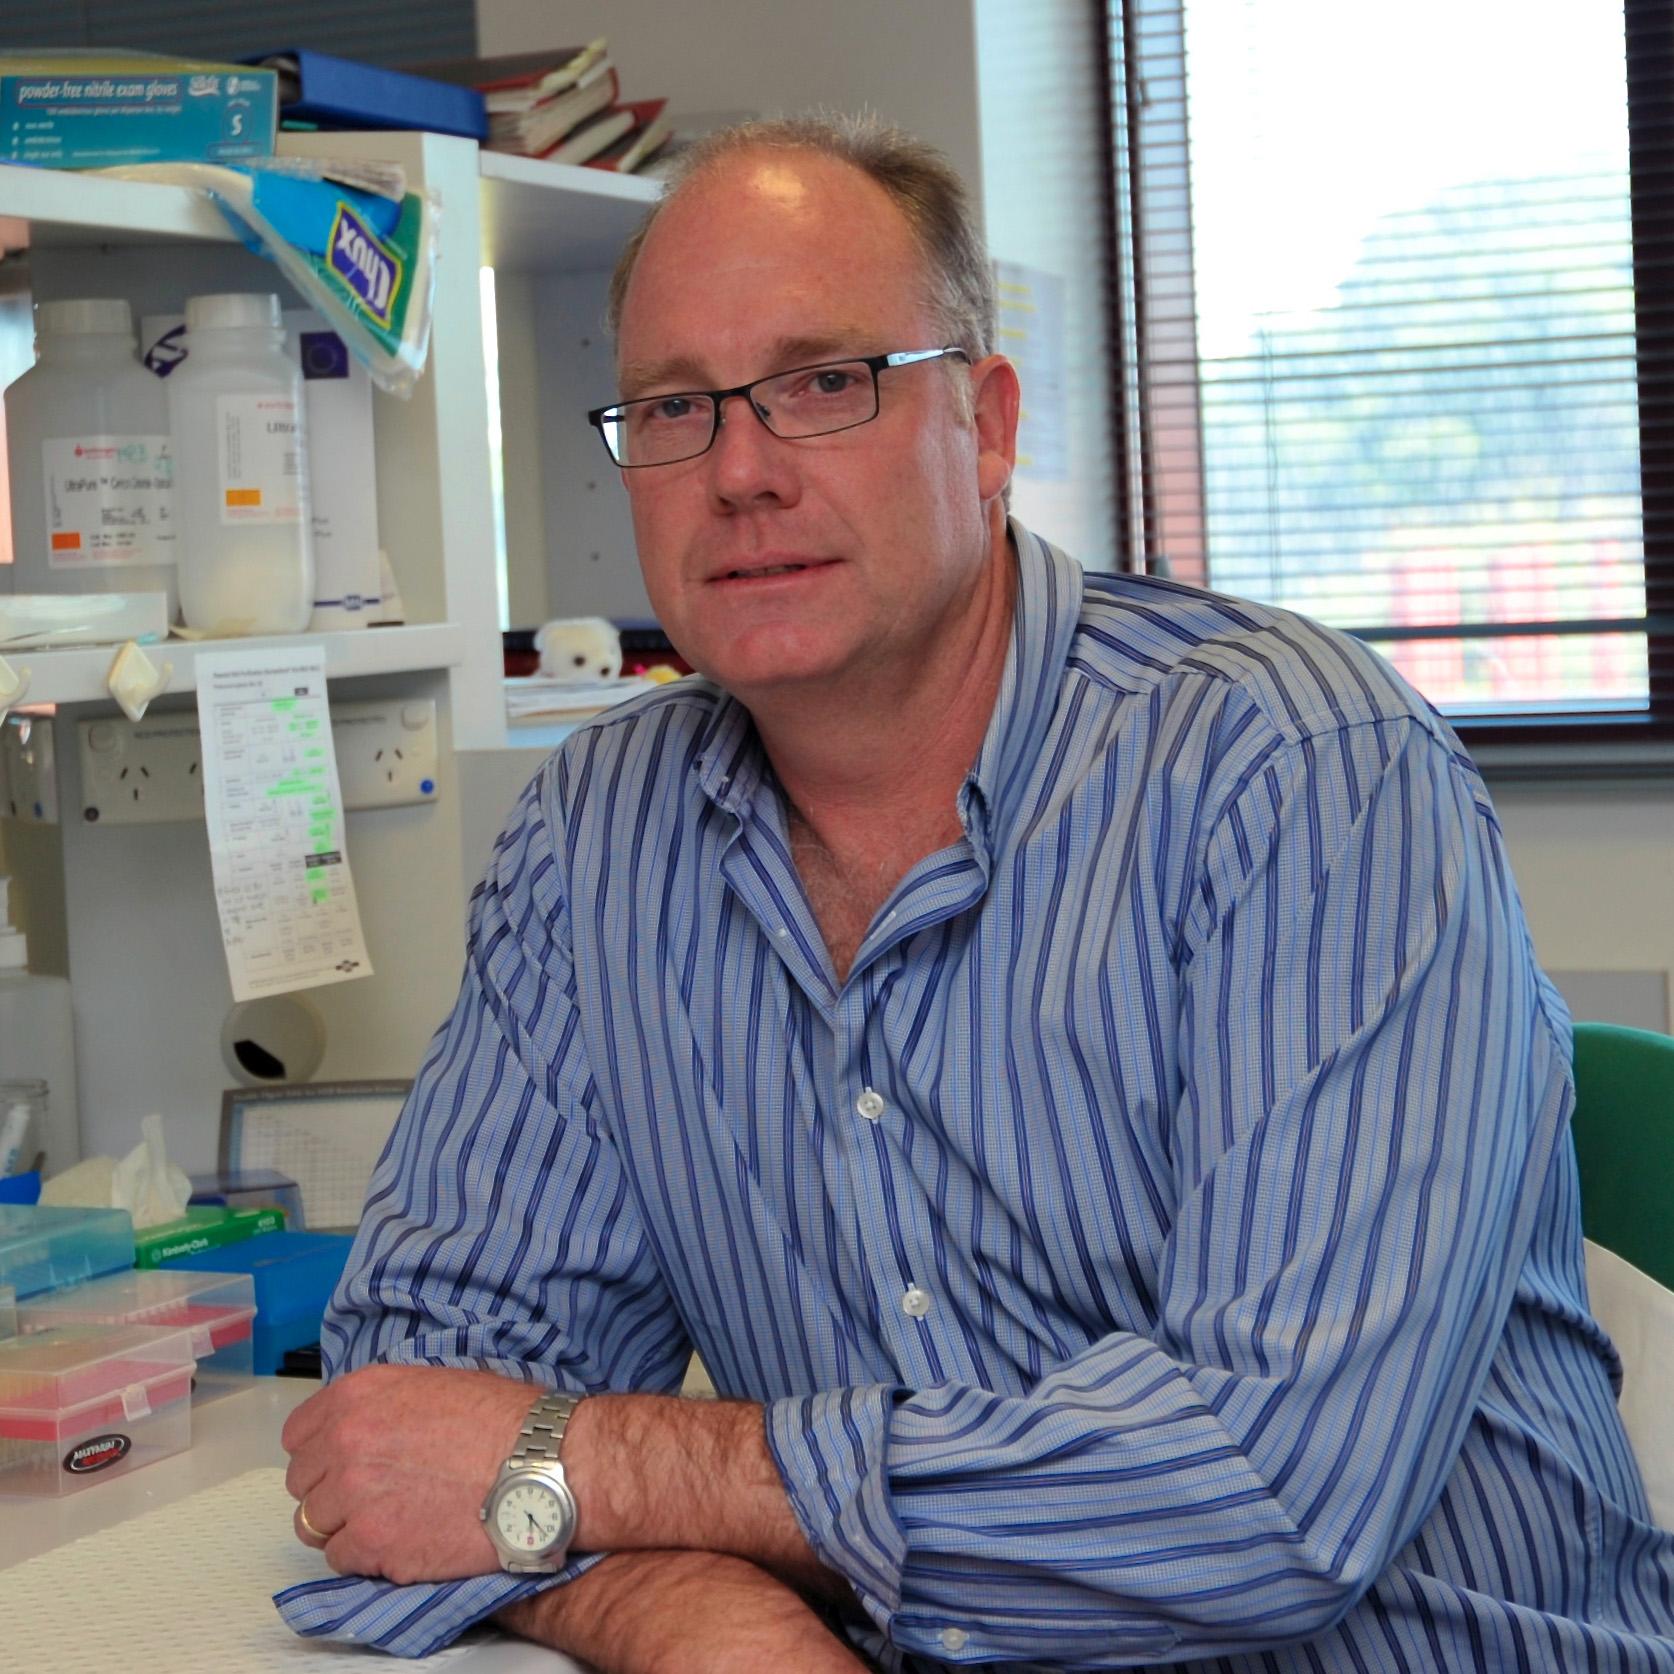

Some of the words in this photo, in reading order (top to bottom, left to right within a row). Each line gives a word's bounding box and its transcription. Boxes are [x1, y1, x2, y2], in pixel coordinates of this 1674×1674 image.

[18, 80, 82, 104] powder-free
[84, 79, 115, 97] nitrile
[116, 84, 144, 98] exam
[145, 79, 178, 102] gloves
[230, 114, 243, 136] S
[336, 217, 392, 310] Chux
